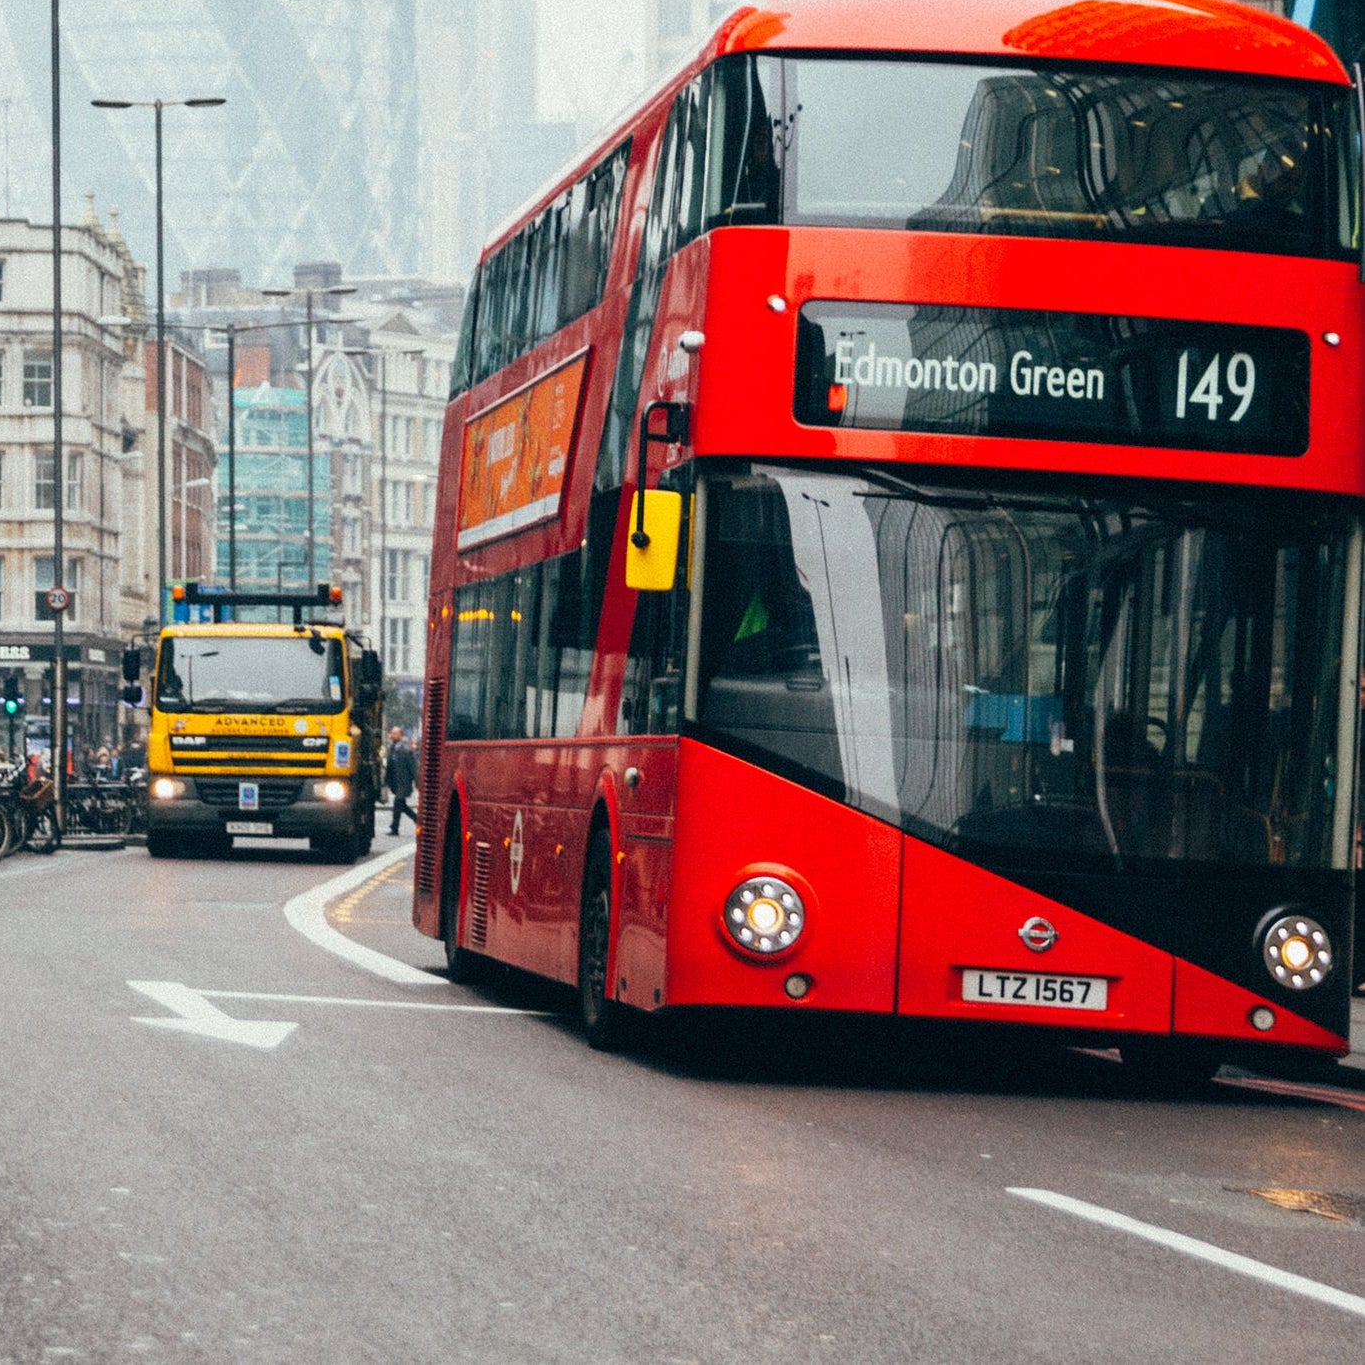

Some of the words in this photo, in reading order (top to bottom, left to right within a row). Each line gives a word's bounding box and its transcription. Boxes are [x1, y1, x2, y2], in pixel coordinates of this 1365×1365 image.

[834, 340, 997, 393] Edmonton
[1010, 349, 1105, 400] Green
[1175, 349, 1256, 422] 149
[50, 592, 66, 604] 20
[215, 717, 286, 727] ADVANCED
[978, 974, 1028, 1000] LTZ
[1035, 978, 1092, 1004] 1567
